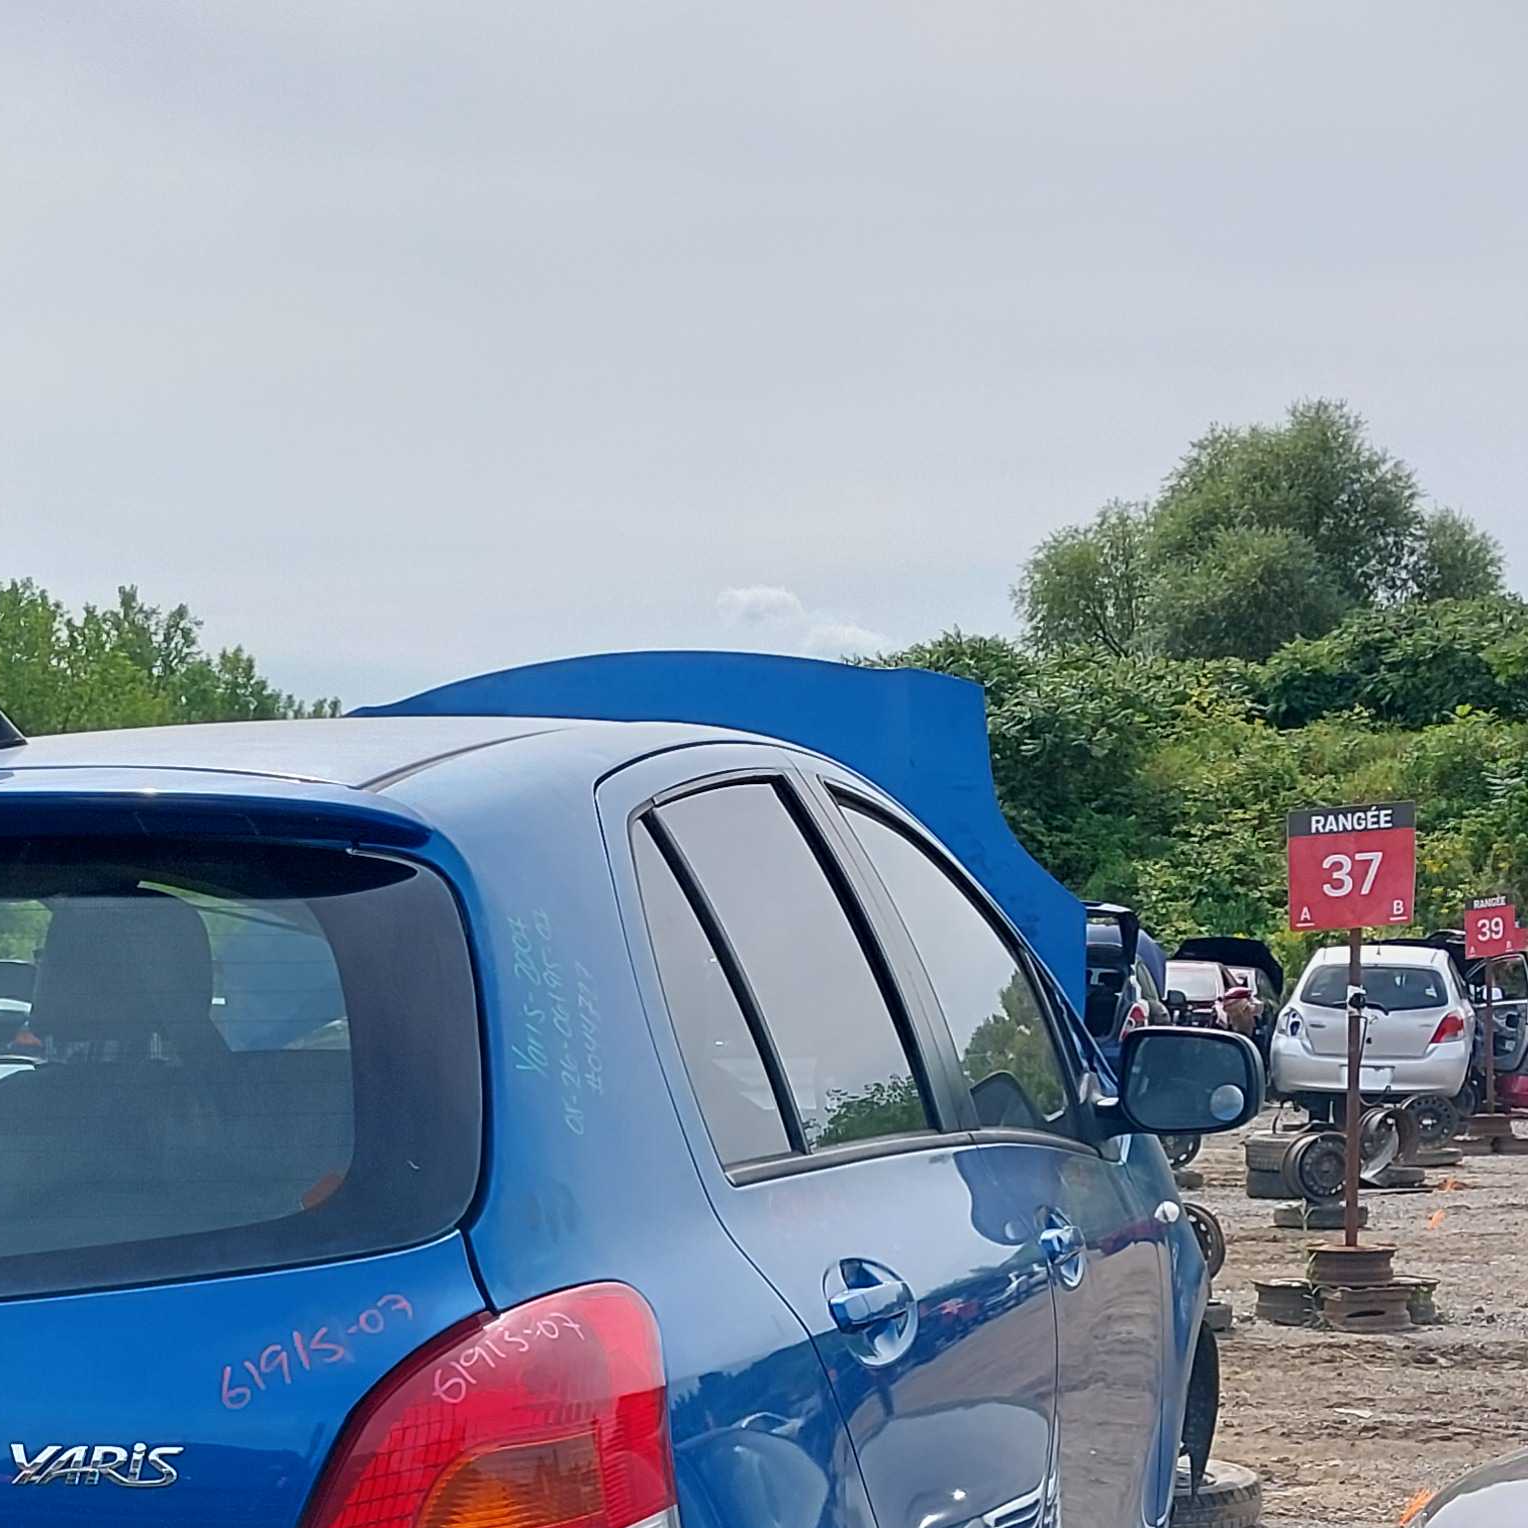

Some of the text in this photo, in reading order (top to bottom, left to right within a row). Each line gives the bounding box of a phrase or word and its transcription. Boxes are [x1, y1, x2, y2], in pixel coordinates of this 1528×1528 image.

[1310, 806, 1393, 834] RANGÉE
[1322, 852, 1384, 897] 37
[1299, 900, 1404, 922] A B
[1477, 916, 1504, 941] 39
